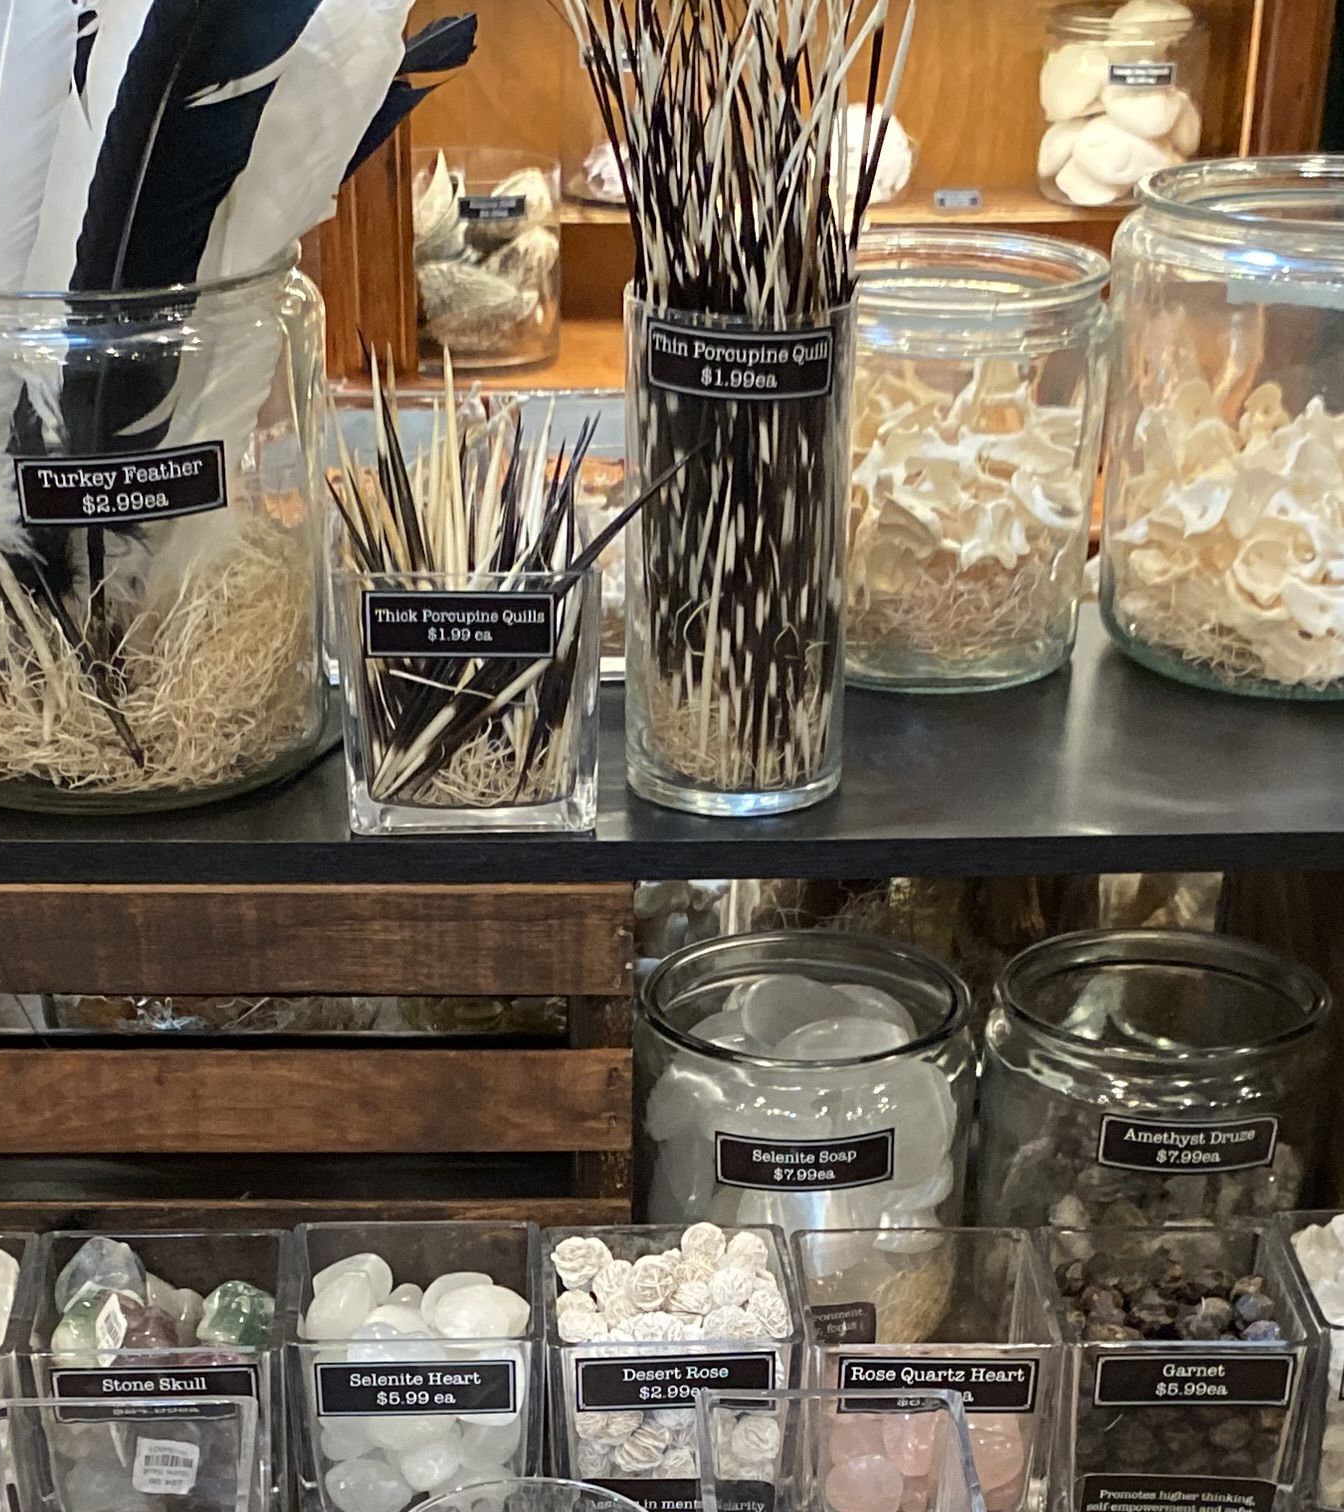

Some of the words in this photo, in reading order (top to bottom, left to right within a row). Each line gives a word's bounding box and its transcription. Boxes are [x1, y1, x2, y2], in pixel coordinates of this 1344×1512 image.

[652, 333, 688, 357] Thin
[693, 341, 788, 366] Porcupine
[700, 365, 777, 388] $1.99ea
[38, 469, 116, 490] Turkey
[122, 460, 203, 484] Feather
[83, 492, 168, 515] $2.99ea
[375, 609, 418, 623] Thick
[422, 610, 498, 625] Porcupine
[502, 610, 544, 626] Quills
[428, 627, 470, 642] $1.99
[474, 630, 493, 641] ea
[1124, 1128, 1206, 1148] Amethyst
[1210, 1130, 1256, 1144] Druze
[753, 1150, 815, 1164] Selenite
[819, 1150, 856, 1163] Soap
[1156, 1149, 1221, 1164] $7.99ea
[774, 1168, 835, 1181] $7.99ea
[622, 1368, 682, 1381] Desert
[686, 1366, 729, 1379] Rose
[850, 1367, 896, 1381] Rose
[901, 1367, 965, 1384] Quartz
[970, 1368, 1025, 1382] Heart
[1163, 1364, 1226, 1377] Garnet
[102, 1379, 155, 1392] Stone
[159, 1377, 207, 1391] Skull
[350, 1373, 424, 1387] Selenite
[428, 1372, 481, 1386] Heart
[639, 1385, 709, 1400] $2.99e
[1155, 1382, 1228, 1397] $5.99ea
[376, 1391, 430, 1406] $5.99
[434, 1393, 456, 1404] ea
[1099, 1490, 1156, 1500] Promotes
[1158, 1490, 1198, 1501] higher
[645, 1500, 657, 1509] in
